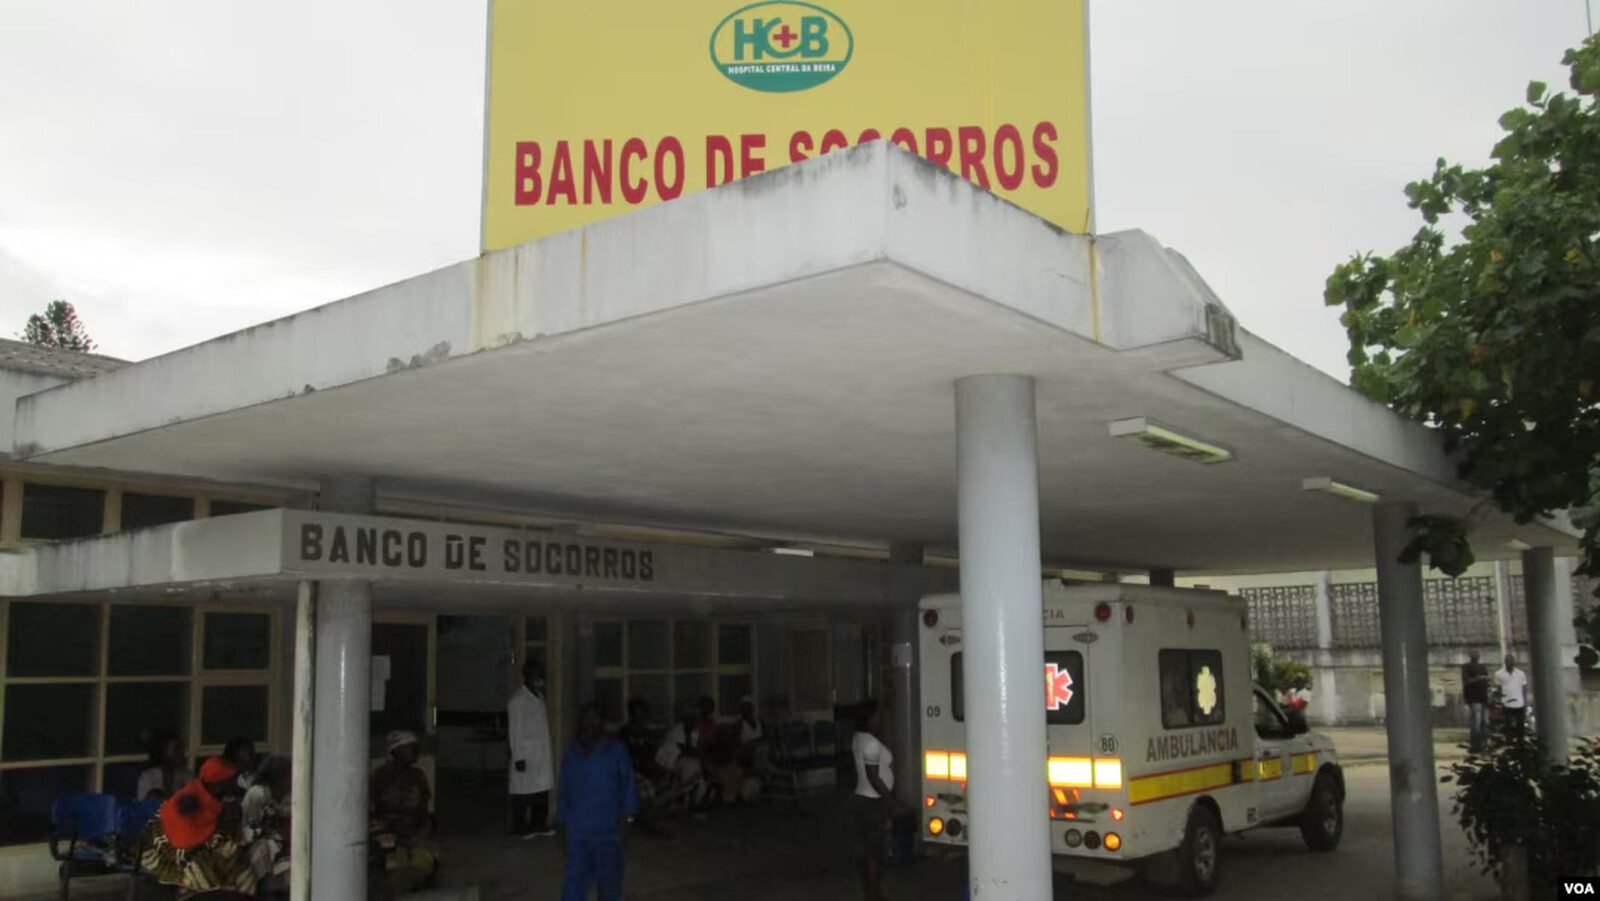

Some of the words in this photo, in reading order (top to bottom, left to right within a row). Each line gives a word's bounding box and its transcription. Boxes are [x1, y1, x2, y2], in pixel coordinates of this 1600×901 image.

[728, 66, 764, 74] HOSPITAL
[766, 64, 799, 73] CENTRAL
[801, 64, 811, 72] DA
[813, 64, 836, 72] BEIRA
[515, 136, 685, 206] BANCO
[706, 134, 766, 189] DE
[301, 523, 427, 568] BANCO
[445, 534, 487, 571] DE
[503, 539, 654, 581] SOCORROS
[1101, 737, 1115, 751] 80
[1146, 728, 1239, 762] AMBULANCIA
